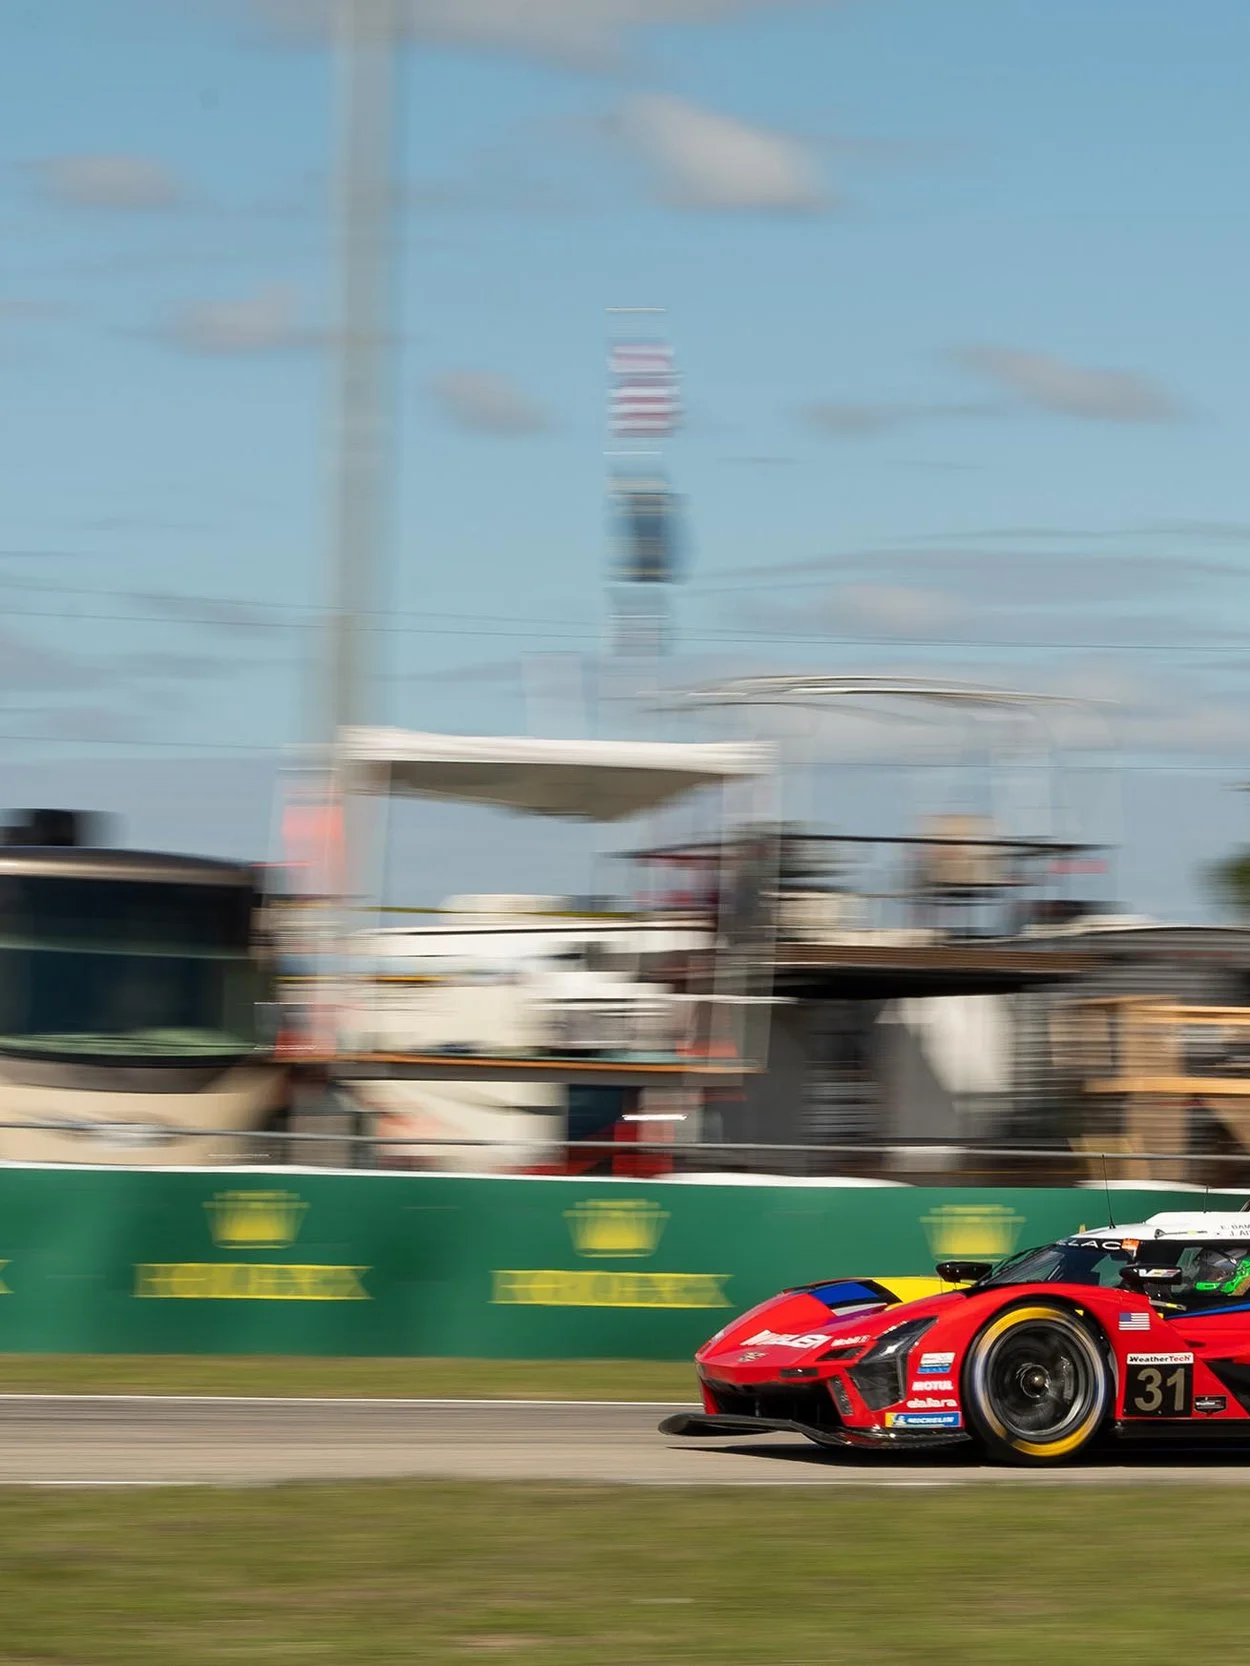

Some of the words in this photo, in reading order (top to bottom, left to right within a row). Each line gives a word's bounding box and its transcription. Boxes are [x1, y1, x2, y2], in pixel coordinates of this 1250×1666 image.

[1129, 1354, 1191, 1363] WeatherTech
[912, 1380, 954, 1391] MOTUL
[1134, 1367, 1185, 1412] 31
